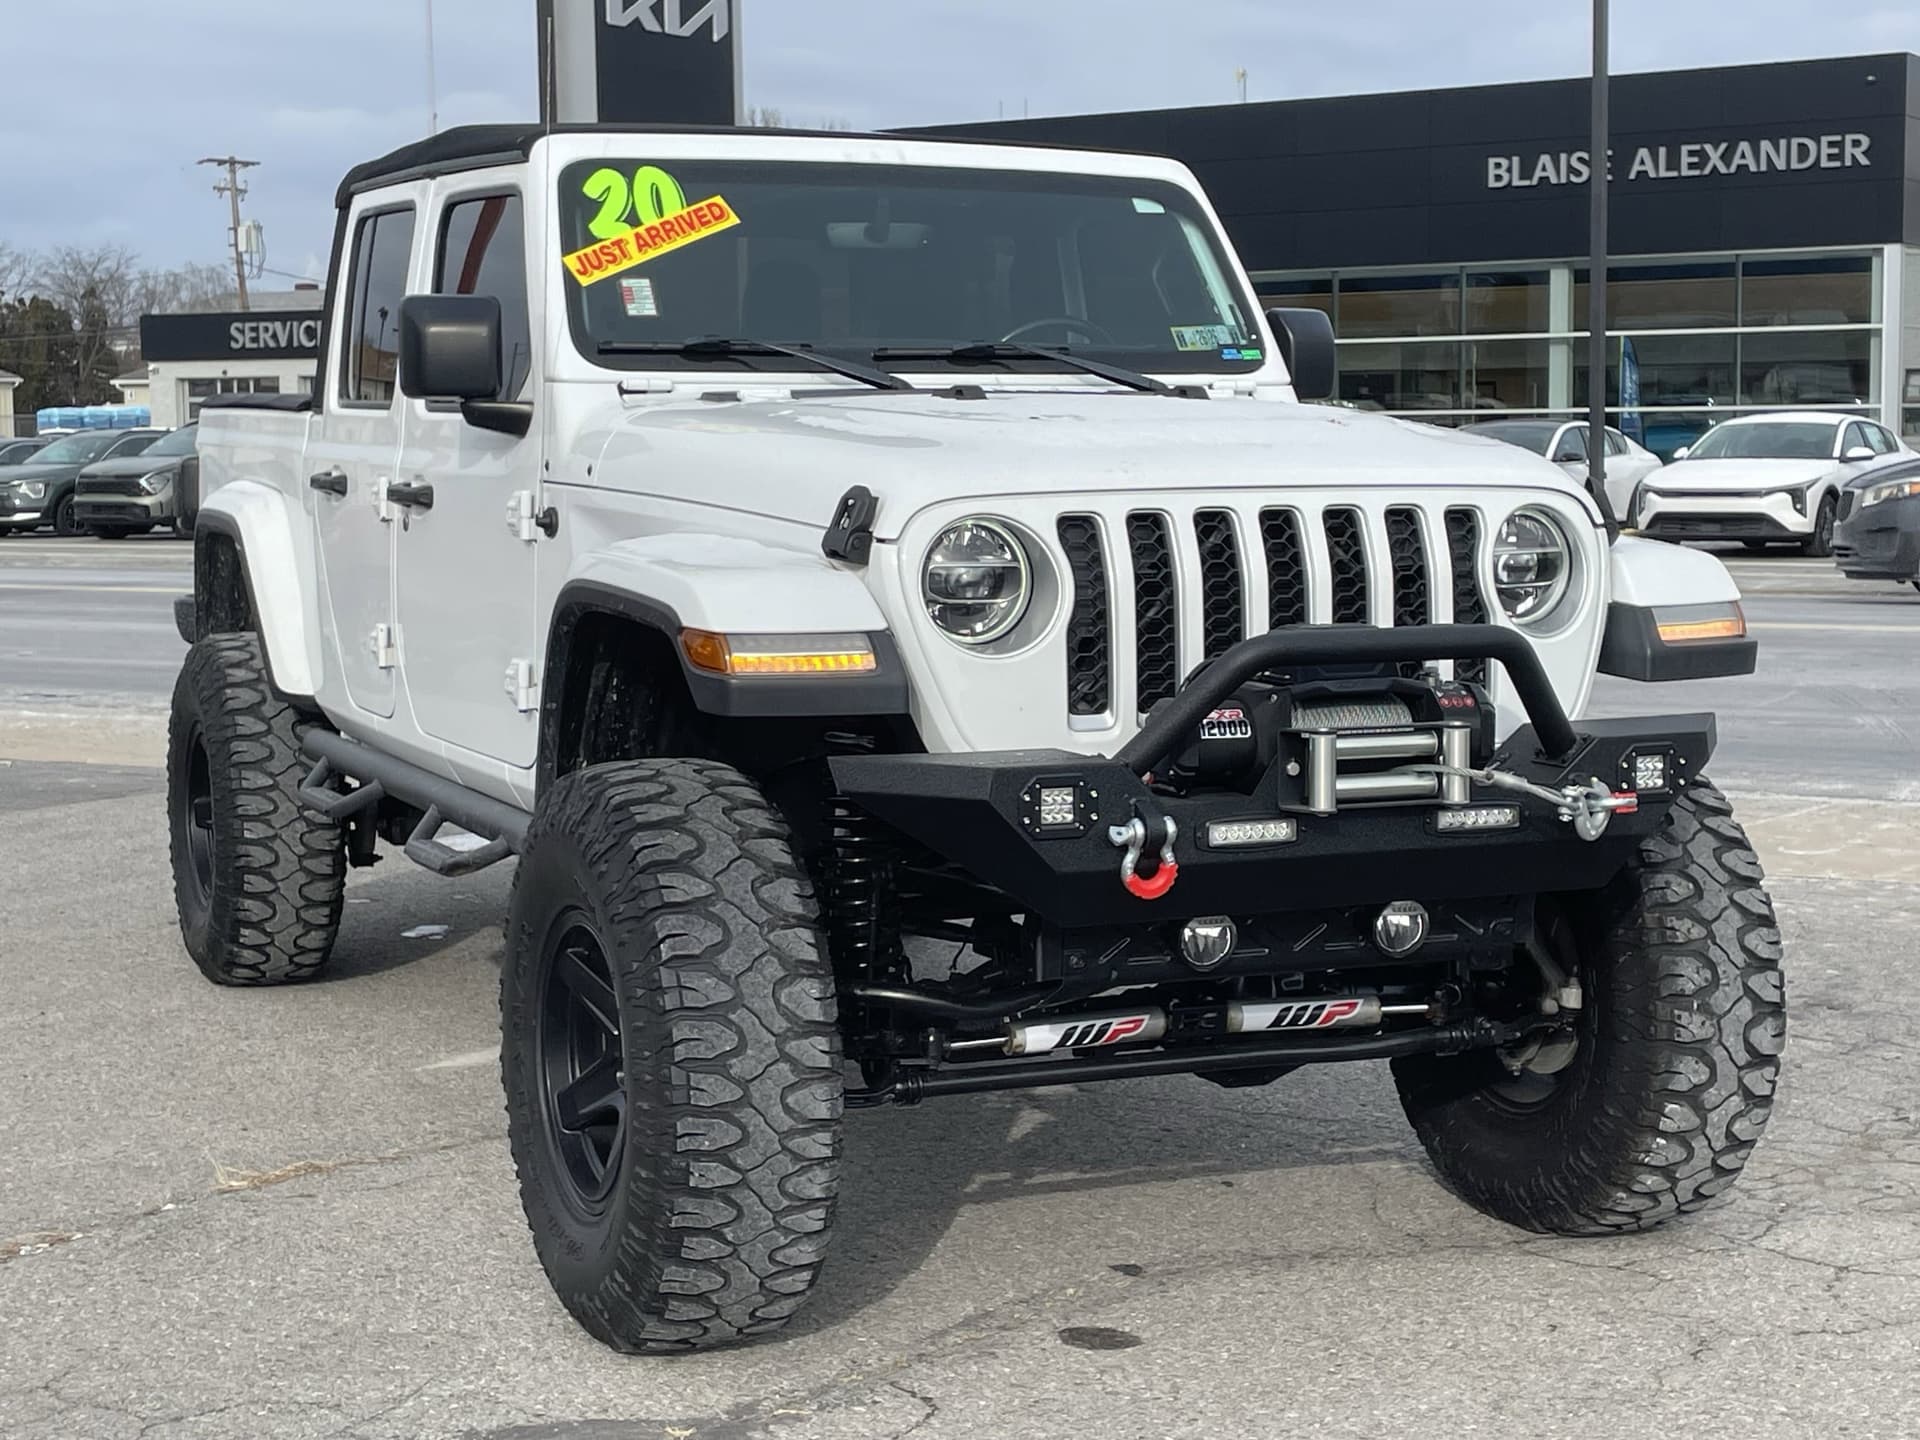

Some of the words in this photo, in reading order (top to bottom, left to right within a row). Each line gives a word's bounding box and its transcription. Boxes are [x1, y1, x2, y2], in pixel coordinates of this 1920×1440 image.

[1628, 132, 1871, 180] ALEXANDER
[575, 238, 631, 277] JUST
[633, 201, 731, 255] ARRIVED
[582, 165, 687, 240] 20
